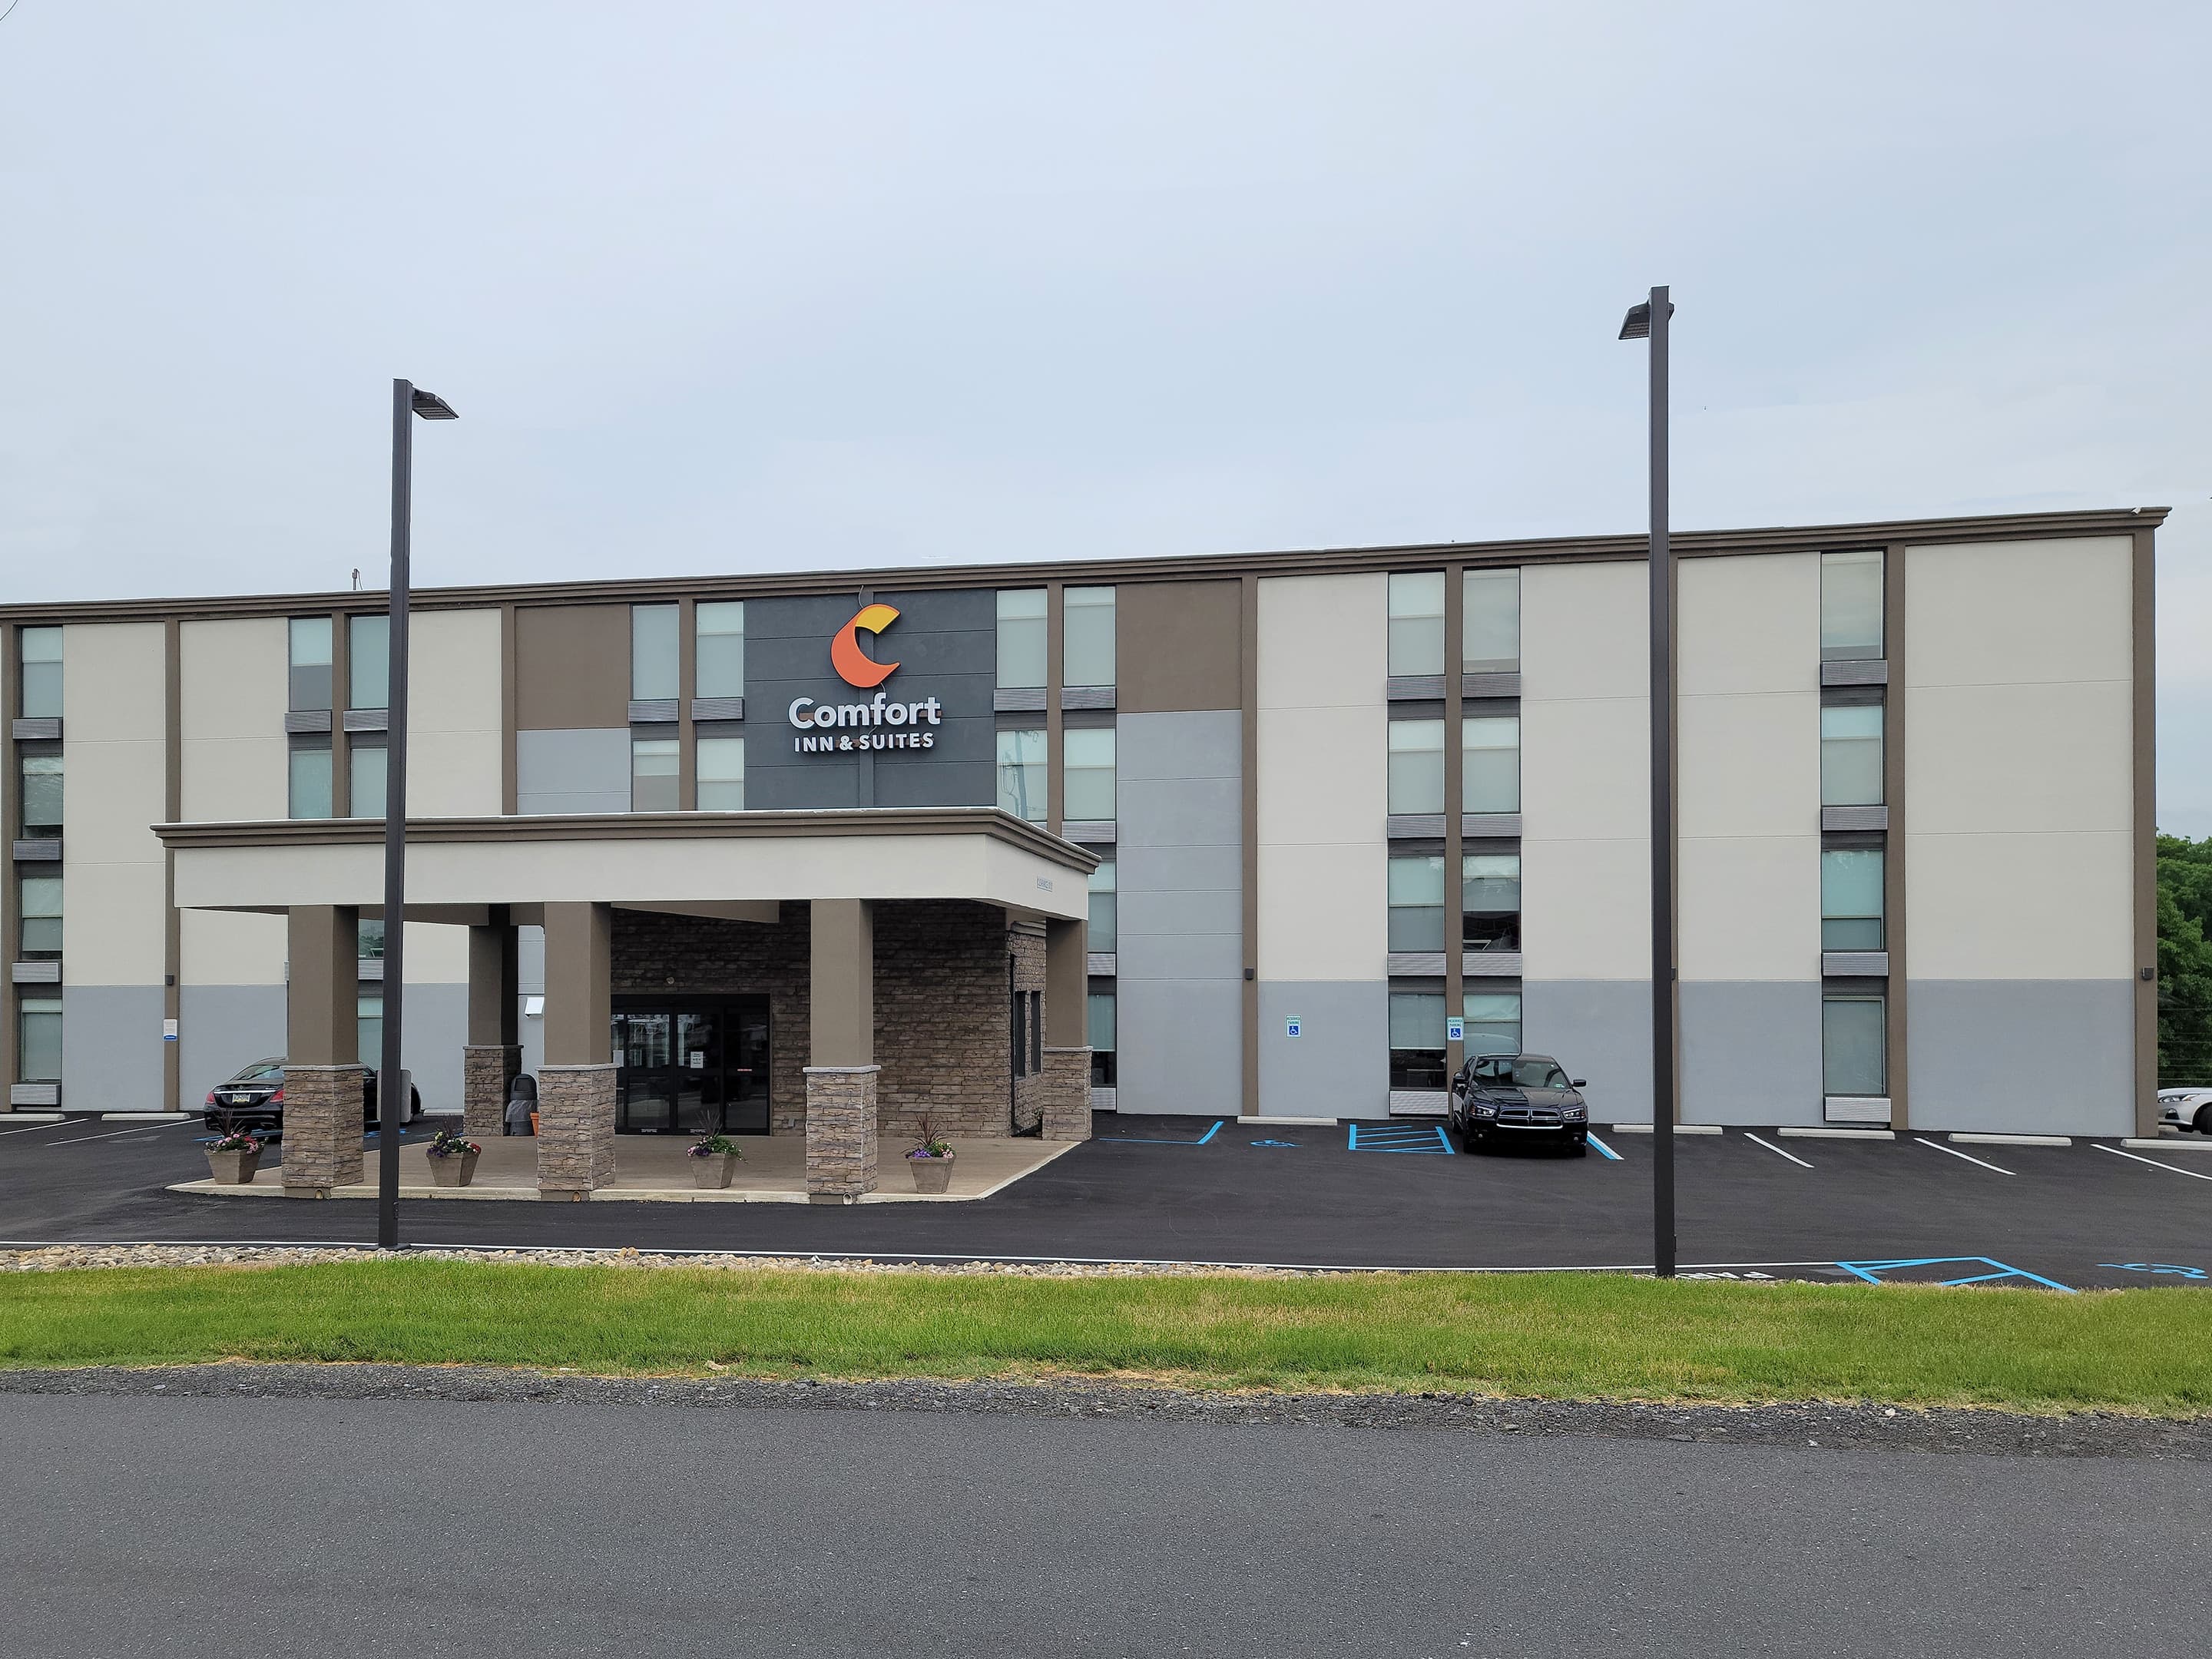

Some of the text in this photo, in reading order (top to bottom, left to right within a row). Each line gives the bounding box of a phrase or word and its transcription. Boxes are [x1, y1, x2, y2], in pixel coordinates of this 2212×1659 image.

[788, 692, 941, 729] Comfort
[794, 732, 934, 753] INN & SUITES
